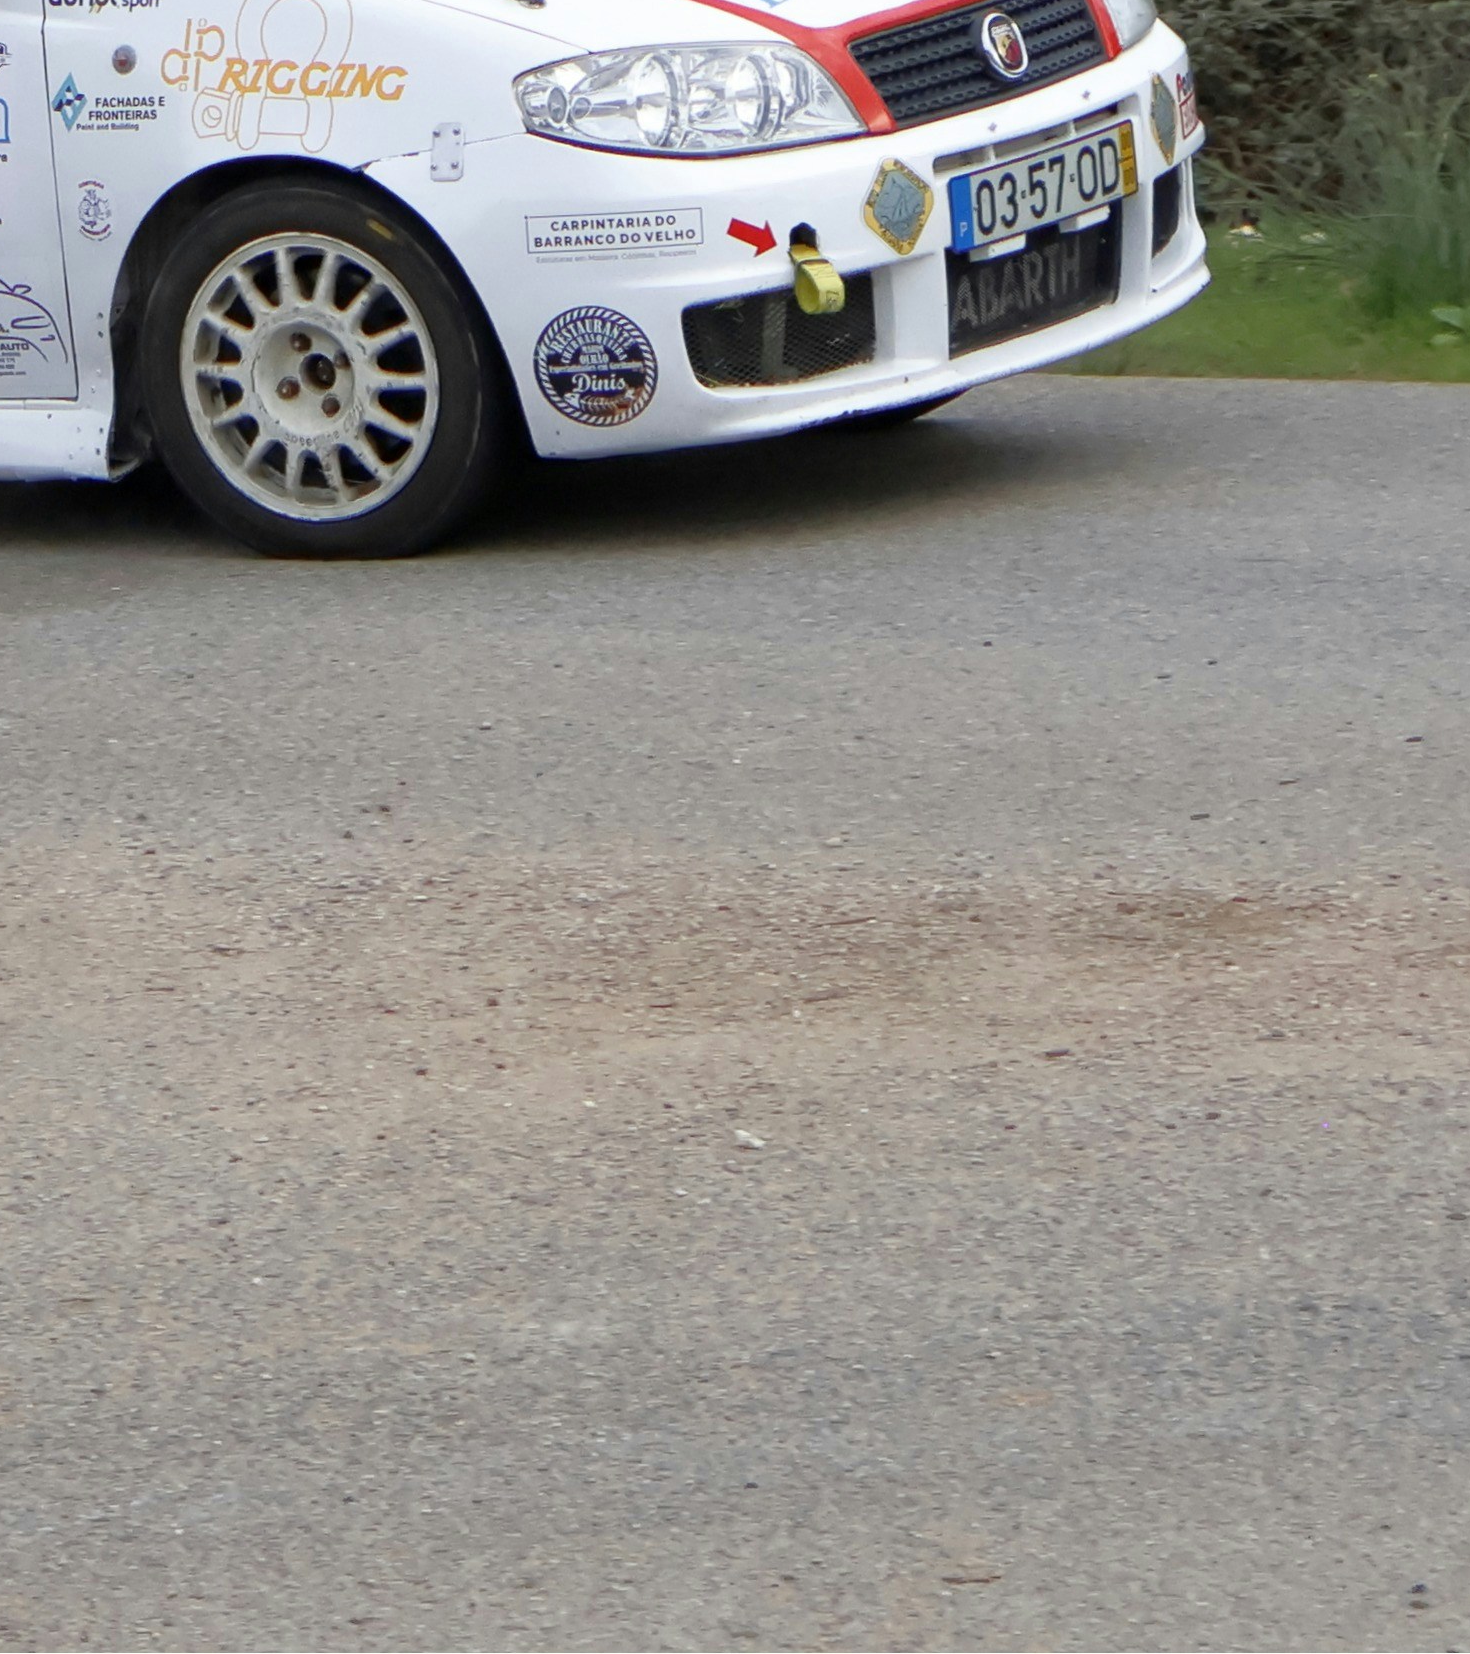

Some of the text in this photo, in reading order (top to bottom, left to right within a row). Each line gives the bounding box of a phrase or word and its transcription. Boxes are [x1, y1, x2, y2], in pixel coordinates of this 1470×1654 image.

[216, 56, 409, 101] RIGGING
[94, 96, 166, 109] FACHADAS E
[88, 109, 158, 121] FRONTEIRAS
[550, 215, 677, 232] CARPINTARIA DO
[534, 228, 696, 247] BARRANCO DO VELHO
[952, 234, 1081, 330] ABARTH
[0, 342, 30, 352] AUTO
[571, 373, 627, 393] Dinis
